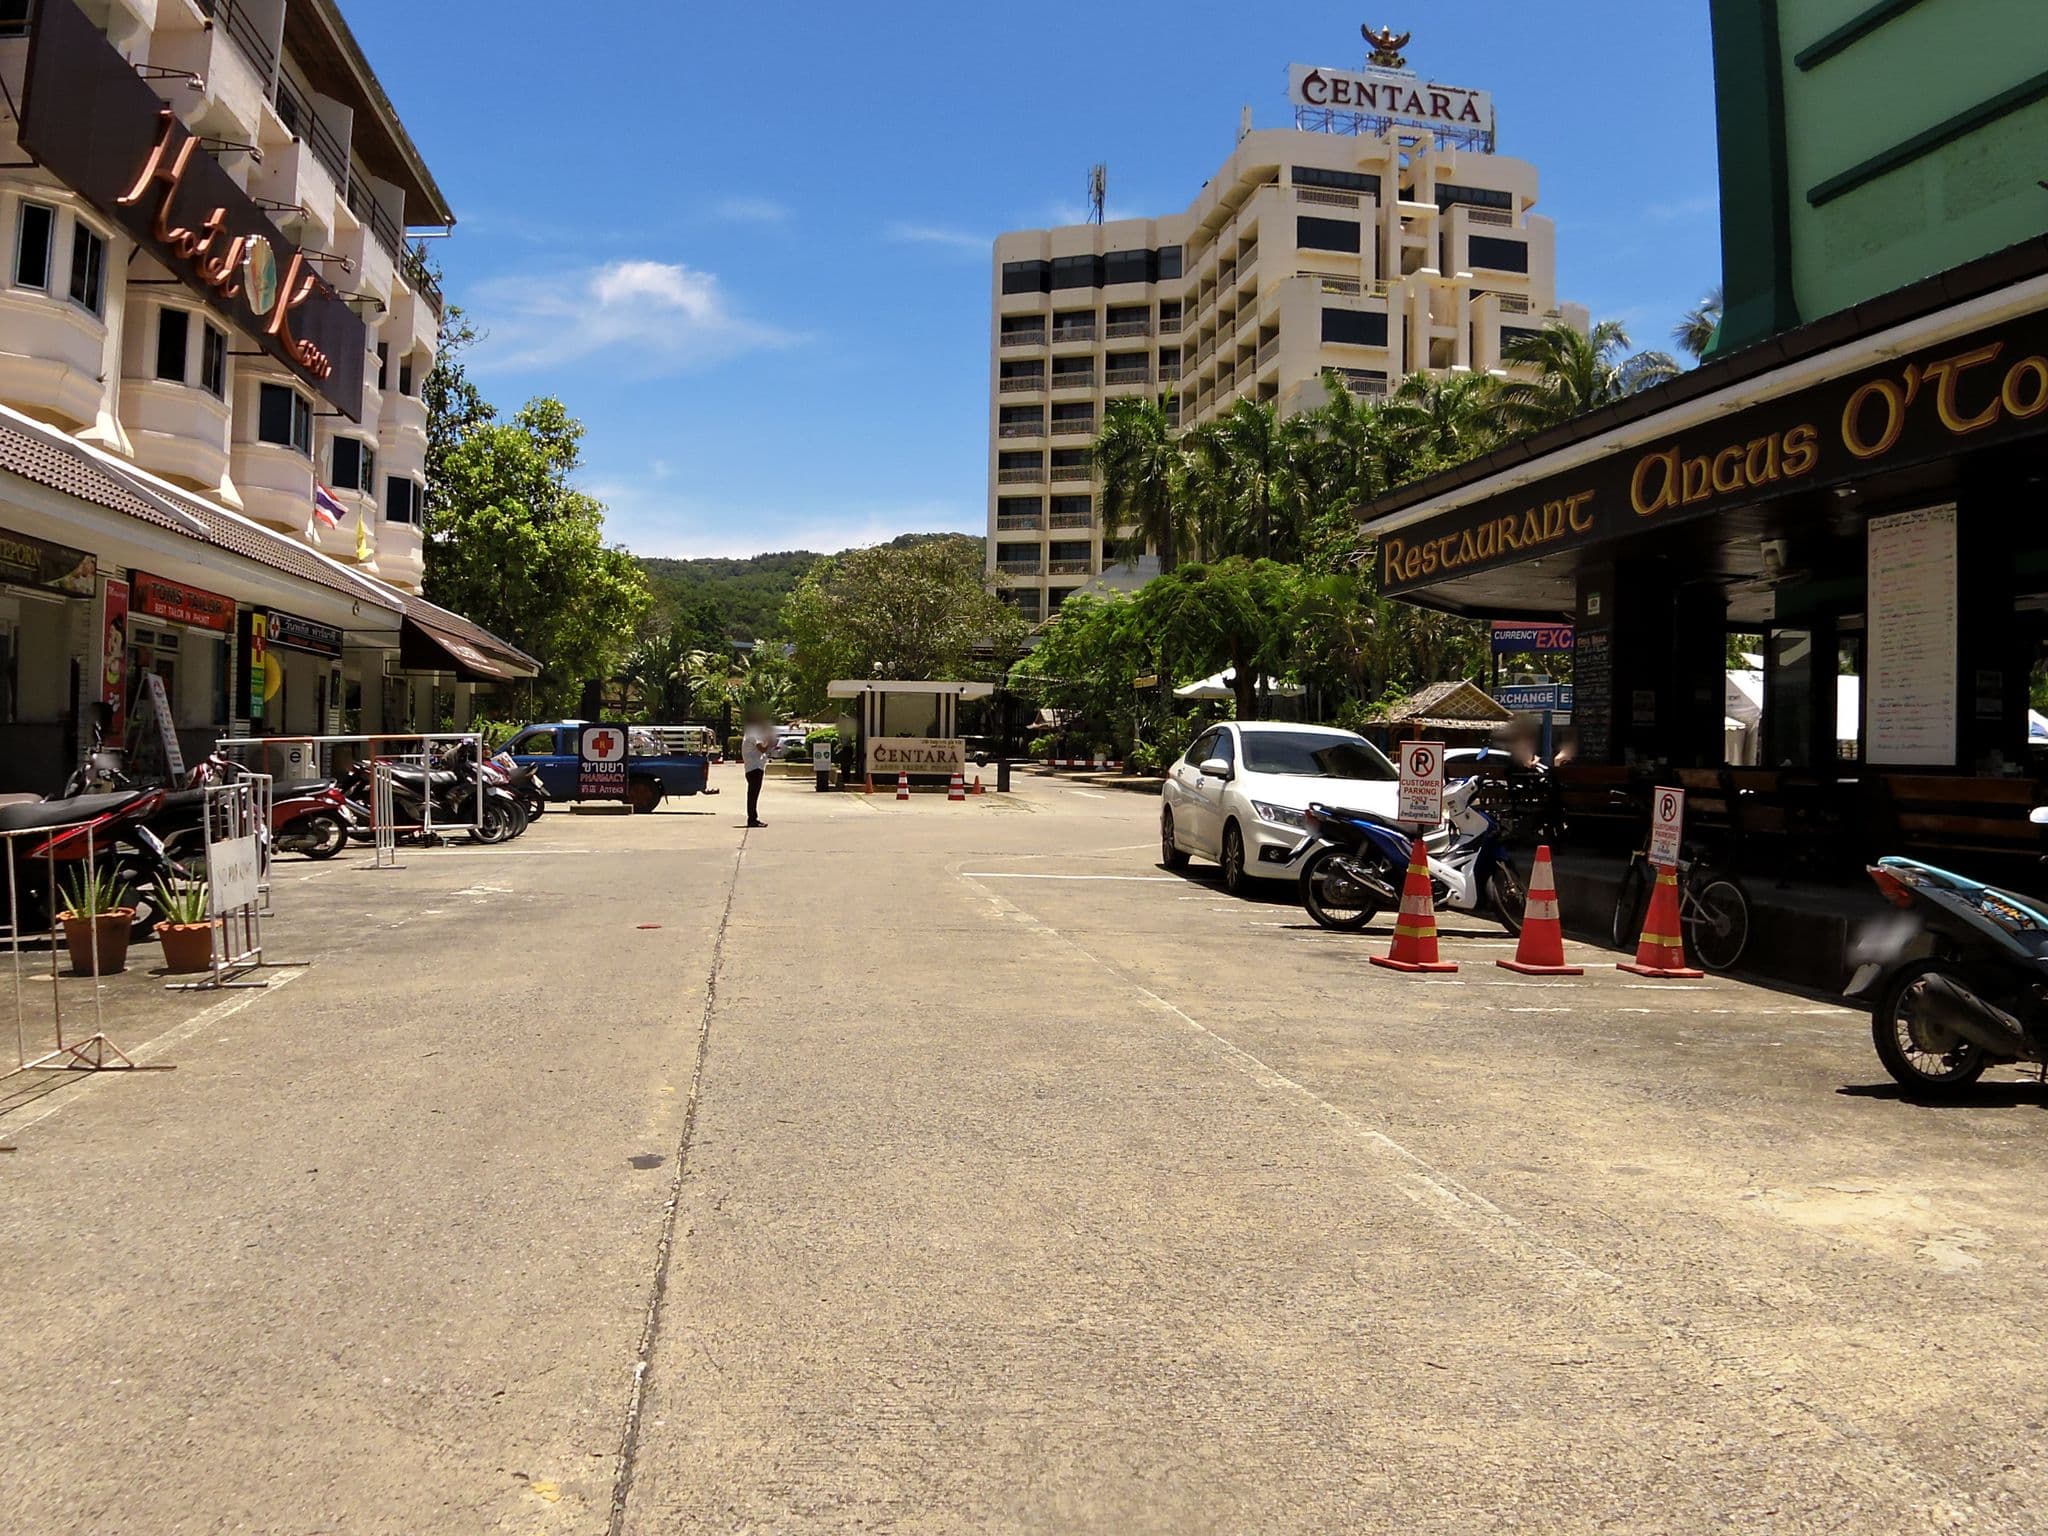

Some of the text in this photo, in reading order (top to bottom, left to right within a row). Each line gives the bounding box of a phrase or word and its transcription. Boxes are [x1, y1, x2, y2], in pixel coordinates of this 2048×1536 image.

[1301, 69, 1481, 123] CENTARA
[116, 109, 245, 298] Hotel
[1494, 629, 1574, 648] CURRENCY EXC
[1493, 692, 1554, 704] EXCHANGE
[1560, 693, 1573, 704] E
[873, 744, 959, 763] CENTARA
[582, 762, 624, 773] ขายยา
[580, 773, 625, 783] PHARMACY
[1401, 779, 1440, 788] CUSTOMER
[1403, 787, 1437, 795] PARKING
